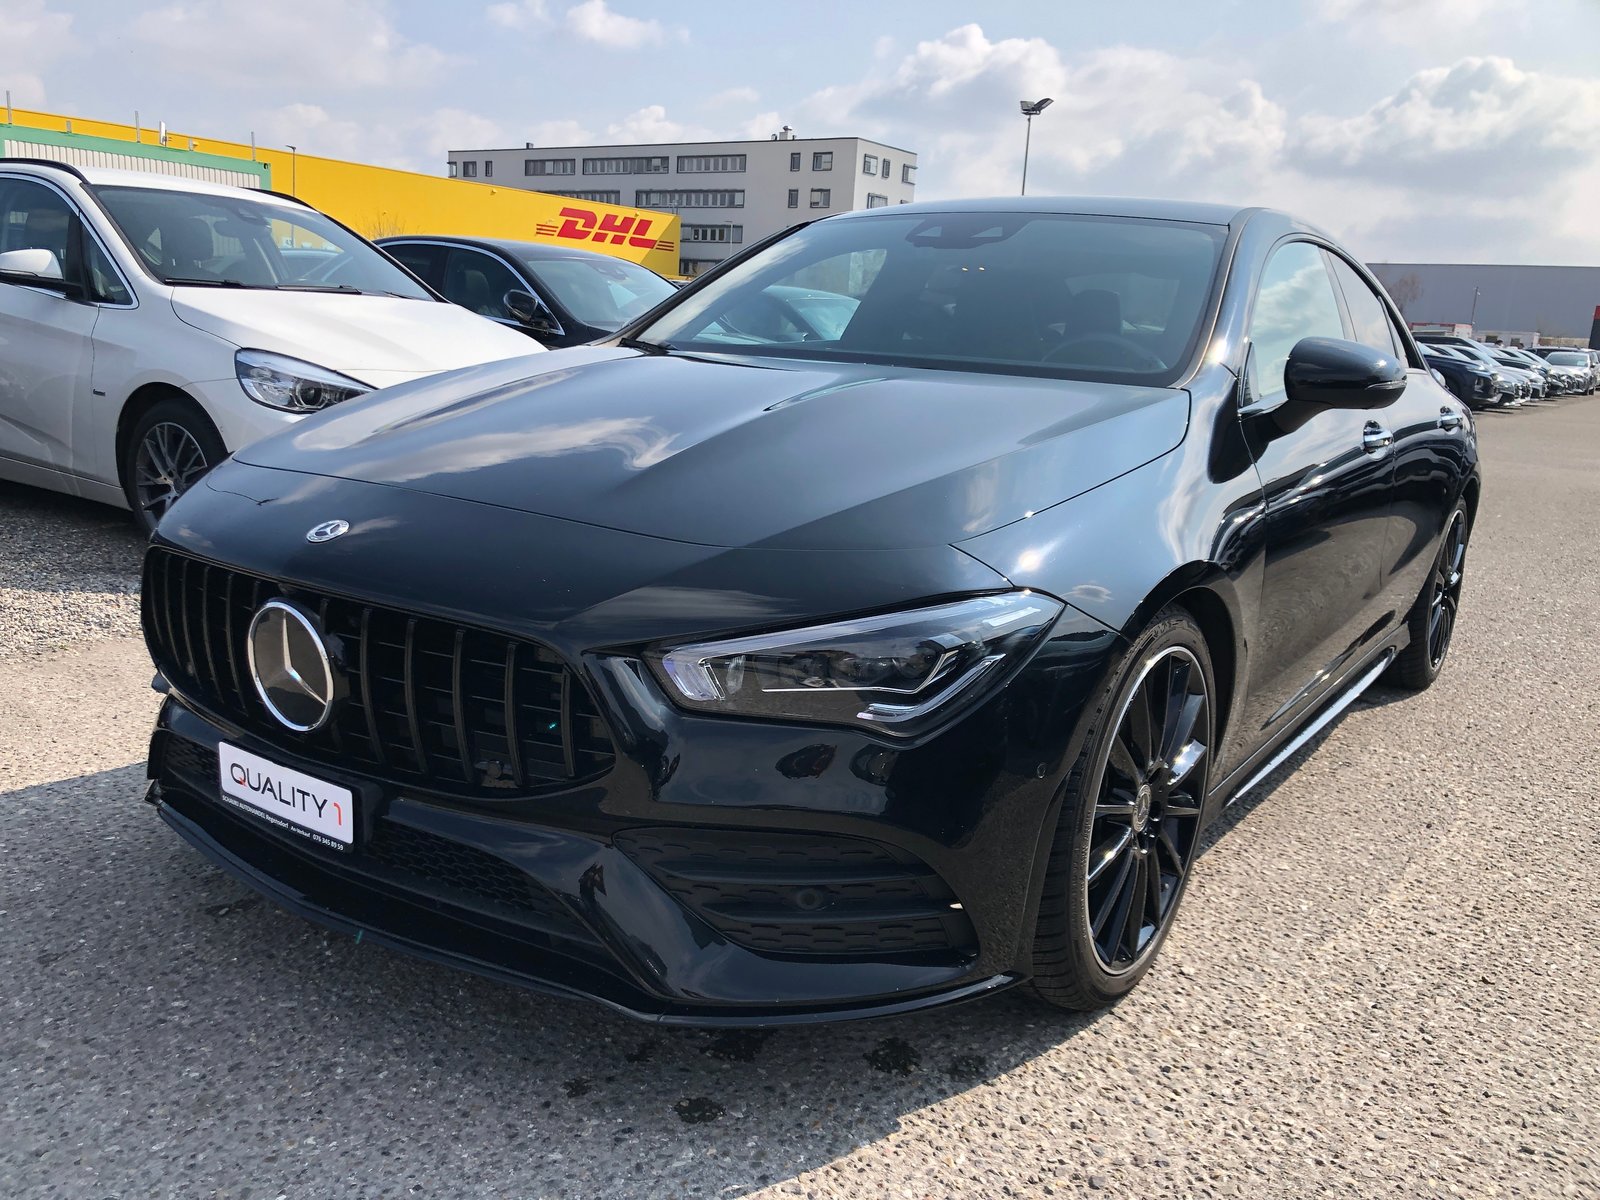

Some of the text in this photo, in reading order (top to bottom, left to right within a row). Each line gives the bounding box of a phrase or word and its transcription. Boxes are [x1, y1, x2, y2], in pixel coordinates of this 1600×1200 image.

[557, 207, 657, 249] DHL
[230, 762, 342, 826] QUALITY 1
